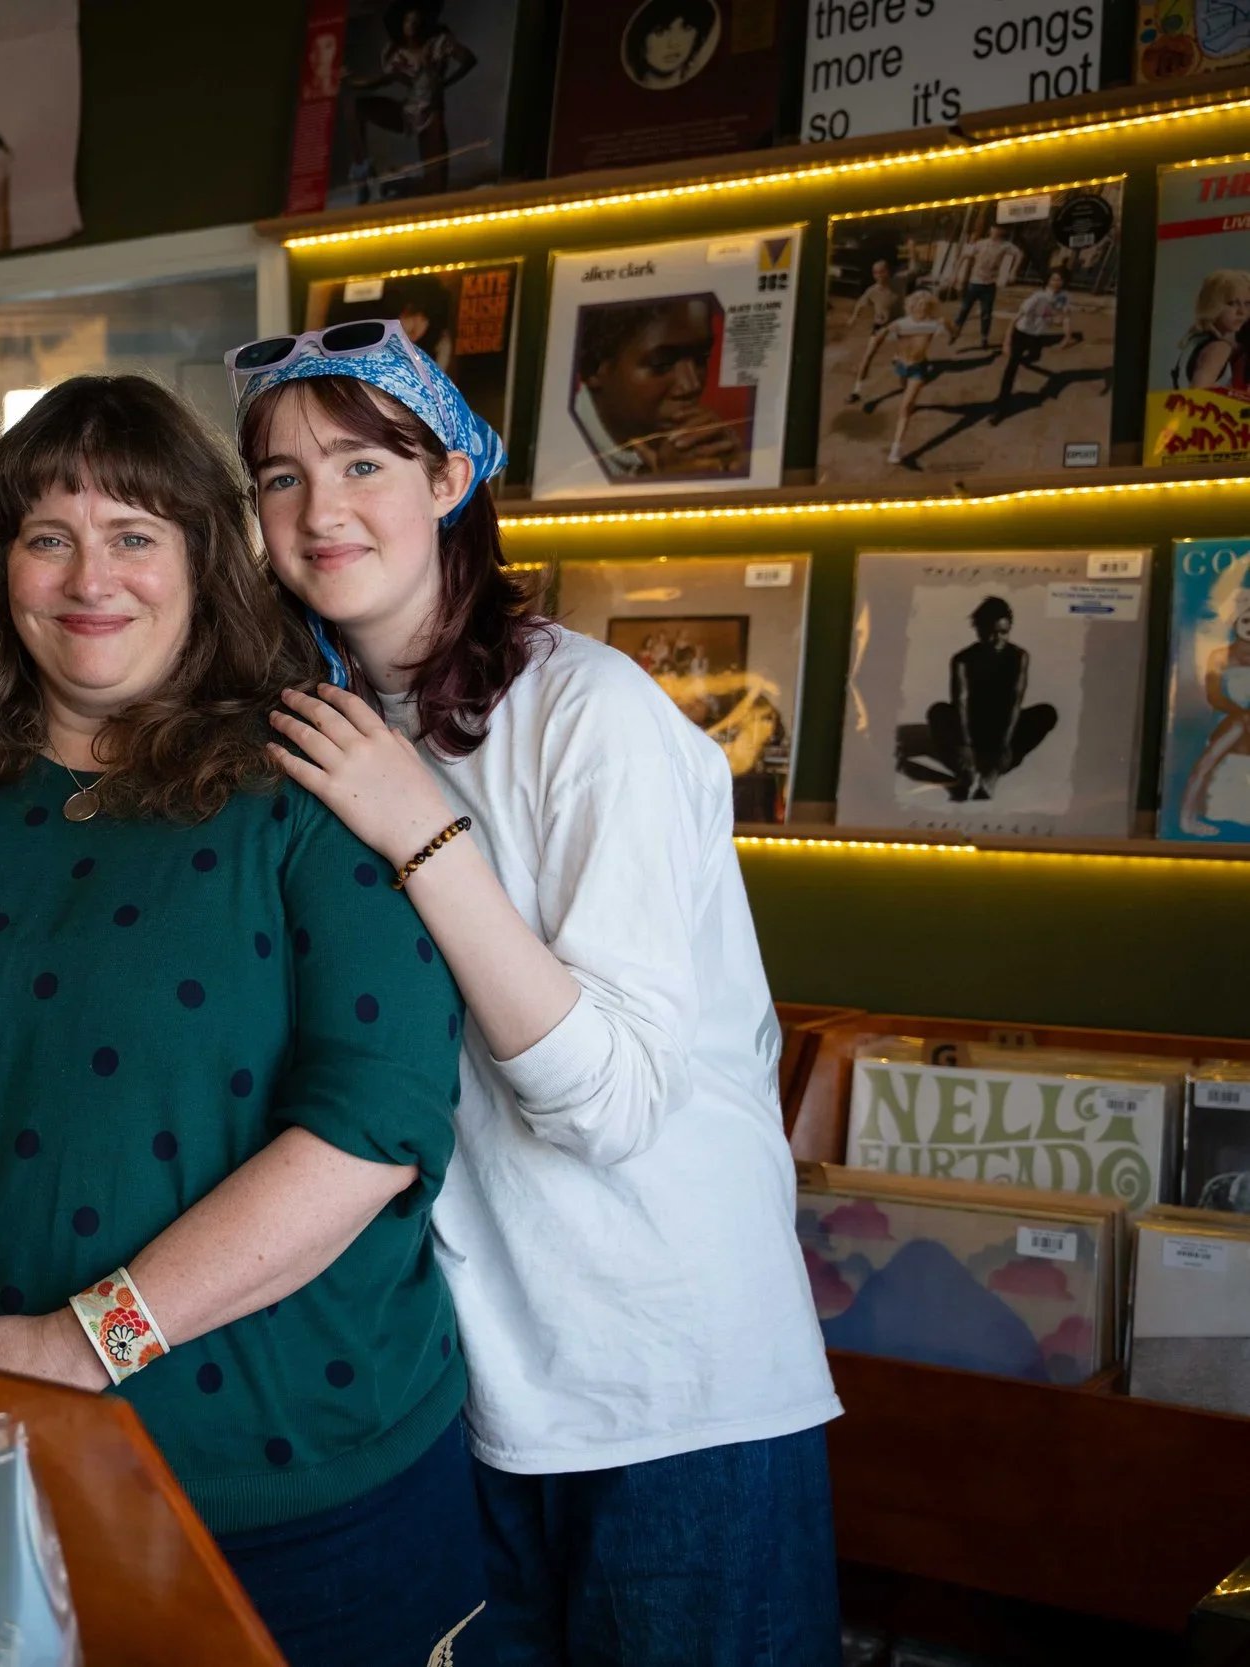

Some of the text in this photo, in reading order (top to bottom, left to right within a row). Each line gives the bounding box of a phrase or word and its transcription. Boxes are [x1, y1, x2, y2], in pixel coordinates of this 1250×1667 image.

[816, 0, 935, 39] theres
[812, 7, 1093, 92] more songs
[809, 53, 1092, 144] so it's not
[581, 261, 656, 282] alice clark
[932, 1044, 957, 1065] G
